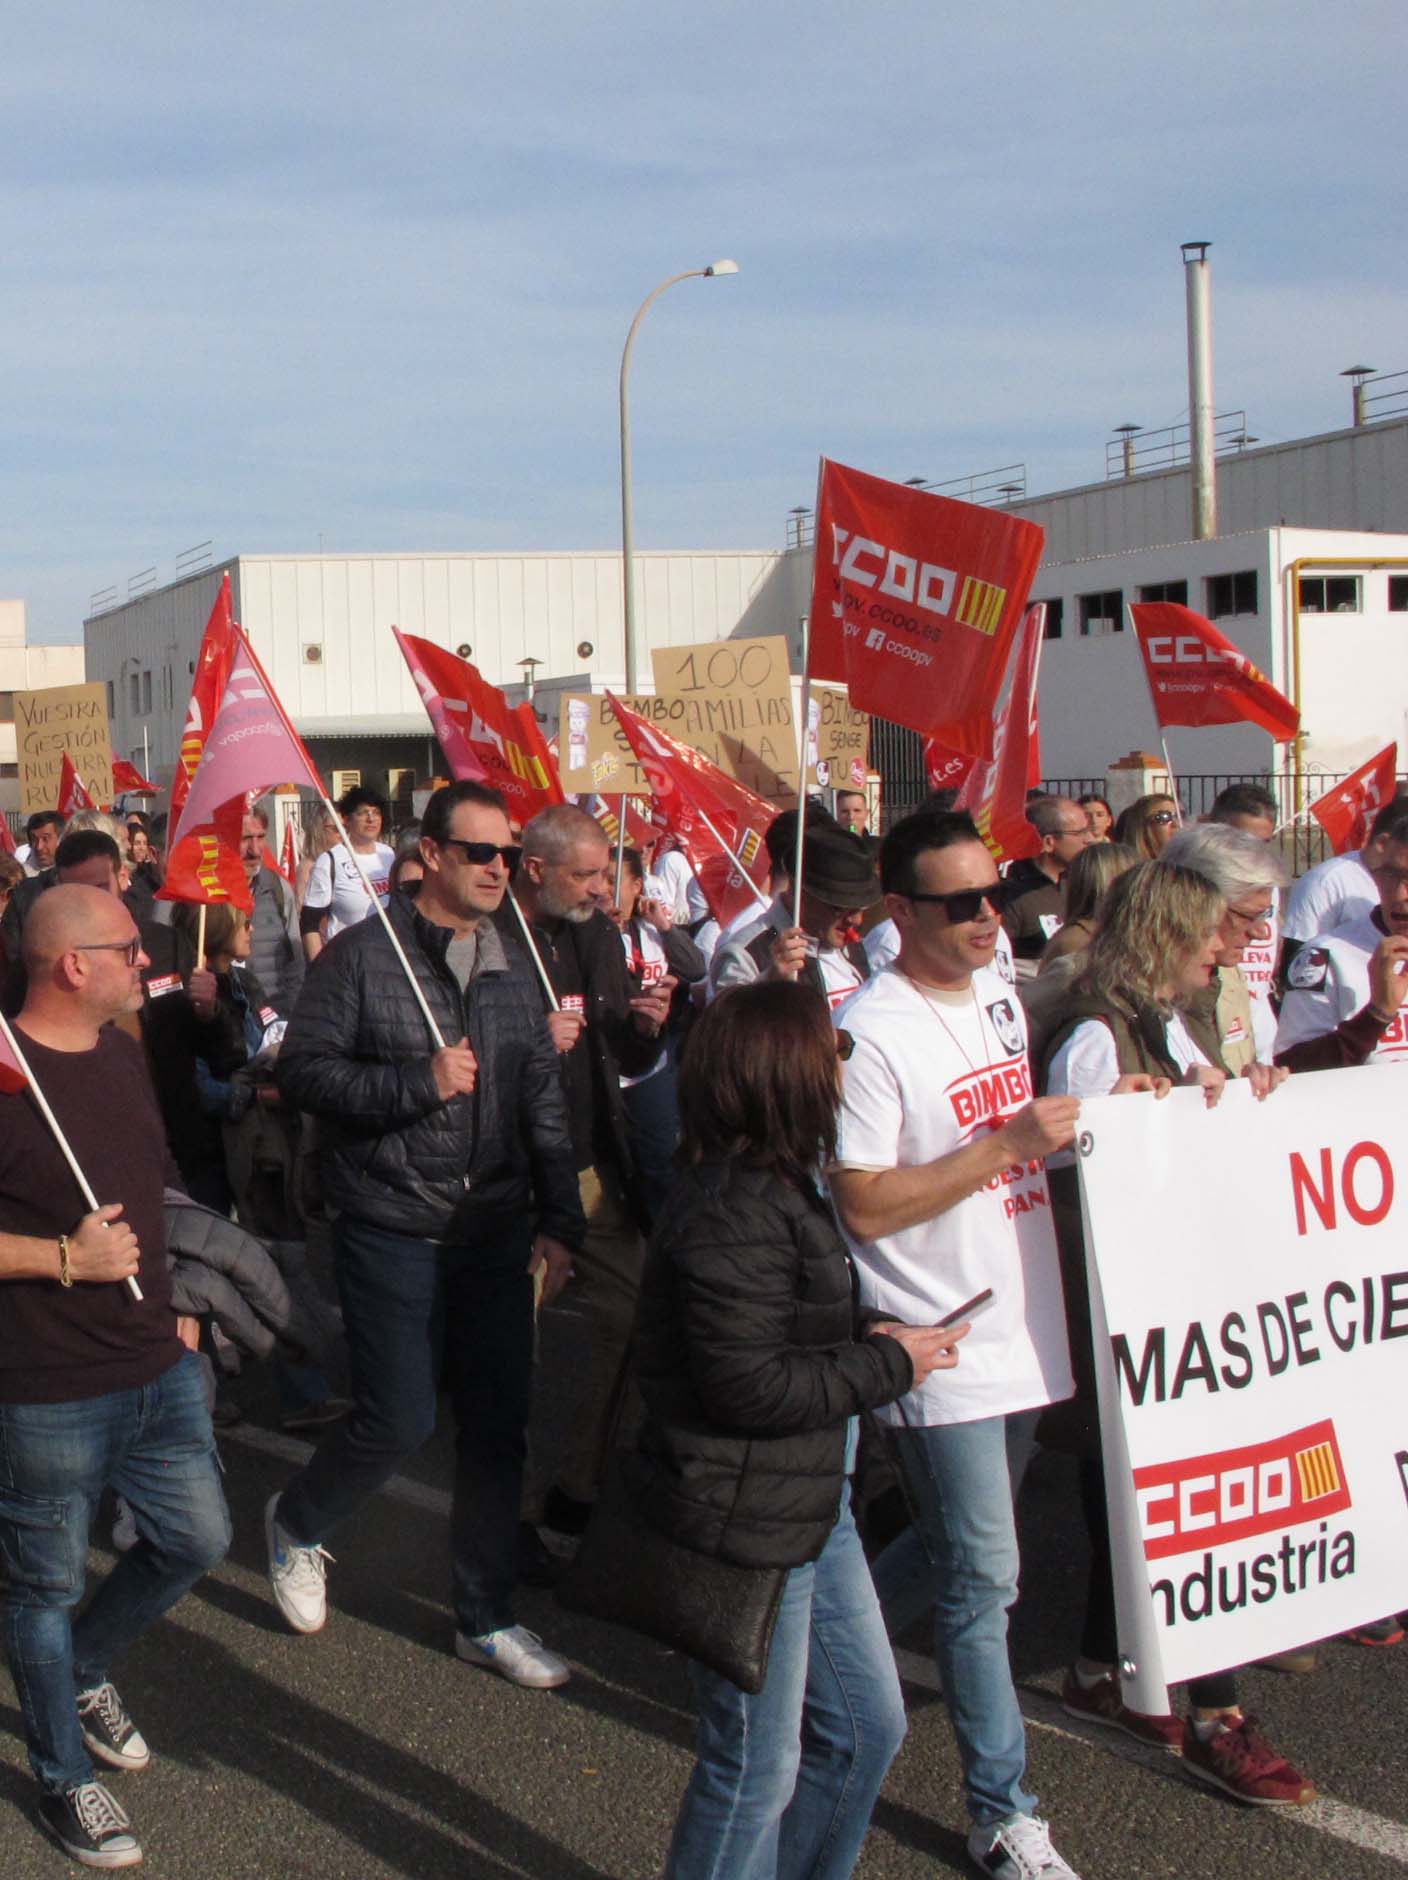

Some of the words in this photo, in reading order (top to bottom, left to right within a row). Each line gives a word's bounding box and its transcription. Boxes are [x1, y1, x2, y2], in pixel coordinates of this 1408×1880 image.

[675, 645, 772, 692] 100
[886, 640, 934, 667] ccoopv
[18, 698, 102, 727] VUESTRA
[685, 691, 792, 733] AMILIAS
[24, 754, 108, 782] NUETRA
[825, 756, 849, 780] TU
[26, 777, 111, 807] RUA!
[1289, 1141, 1395, 1236] NO
[1110, 1312, 1253, 1407] MAS
[1256, 1291, 1321, 1377] DE
[1323, 1271, 1408, 1353] CIE
[1136, 1457, 1291, 1540] CCOO
[1151, 1521, 1356, 1627] ndustria
